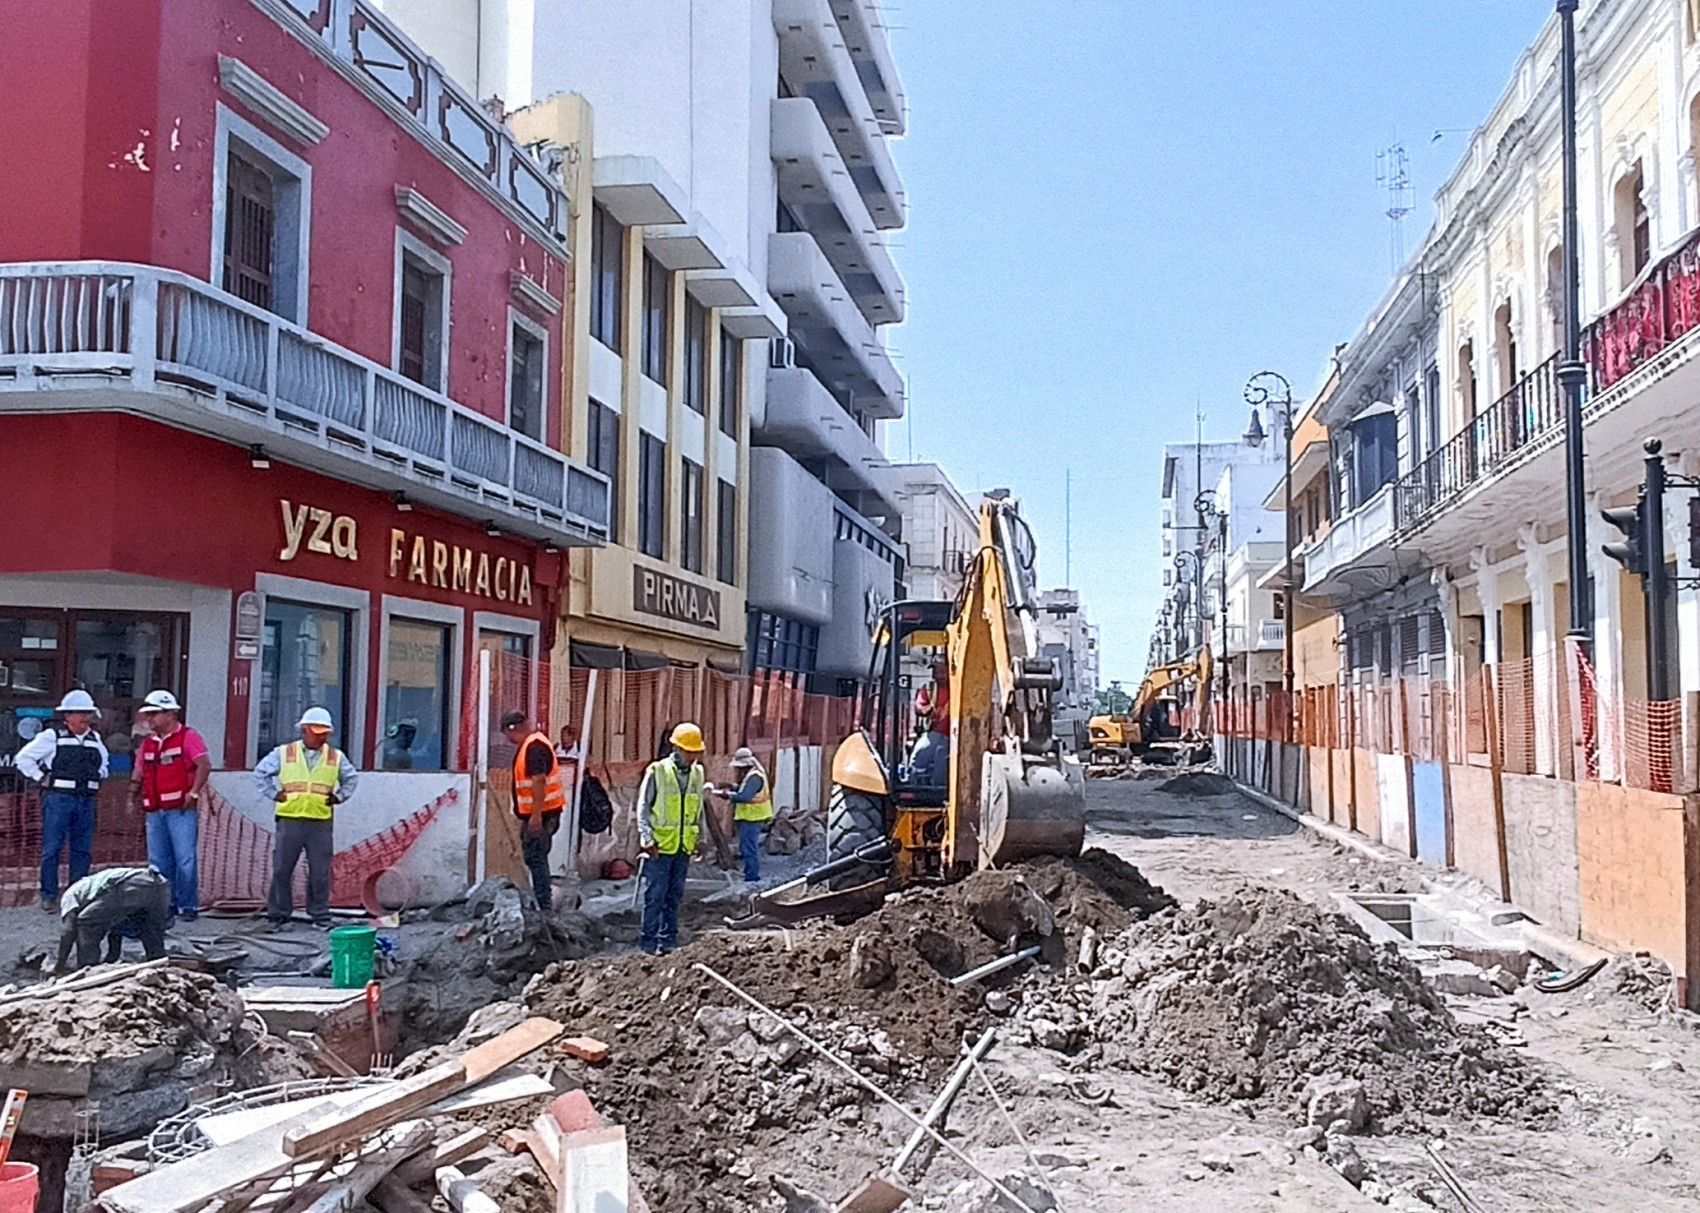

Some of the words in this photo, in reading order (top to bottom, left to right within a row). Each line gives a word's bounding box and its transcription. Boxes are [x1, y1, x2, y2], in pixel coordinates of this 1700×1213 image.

[280, 499, 358, 561] yza
[389, 528, 533, 606] FARMACIA
[643, 571, 700, 621] PIRMA
